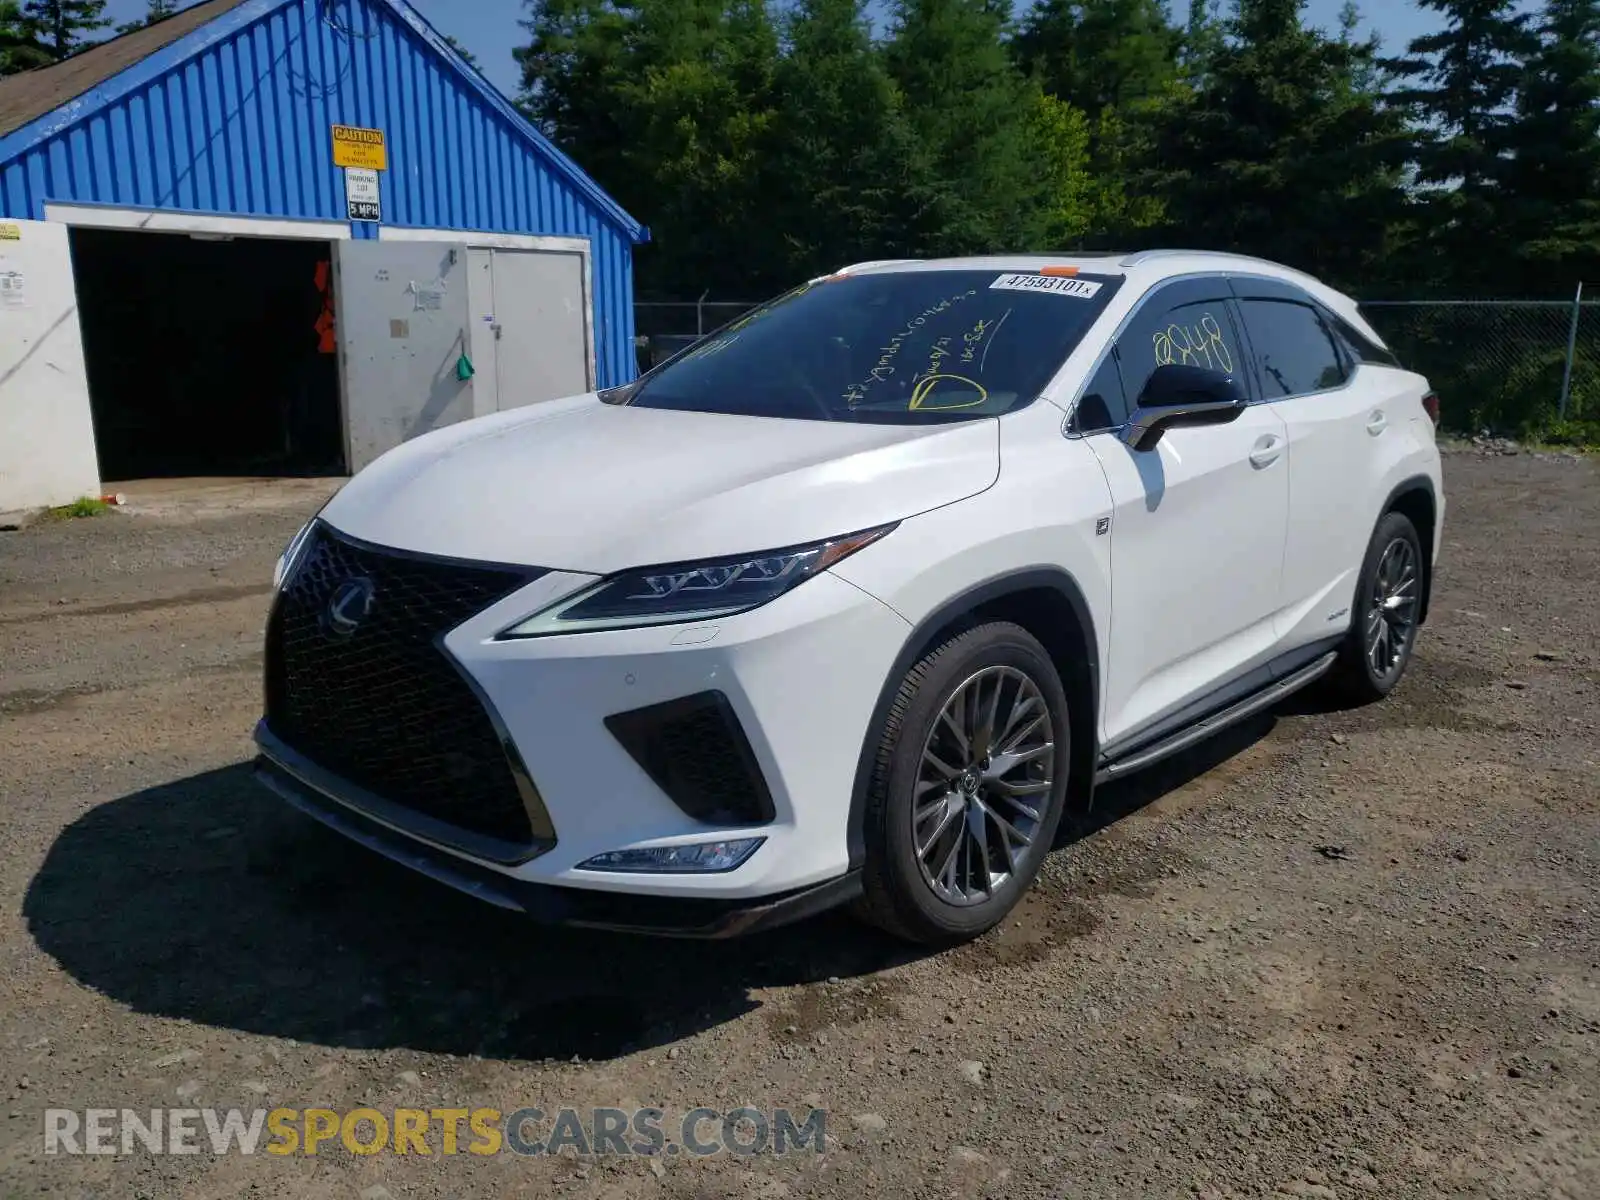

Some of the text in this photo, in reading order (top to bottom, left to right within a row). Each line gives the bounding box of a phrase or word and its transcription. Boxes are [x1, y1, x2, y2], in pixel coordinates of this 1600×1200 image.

[335, 127, 383, 144] CAUTION
[350, 203, 378, 217] 5 MPH
